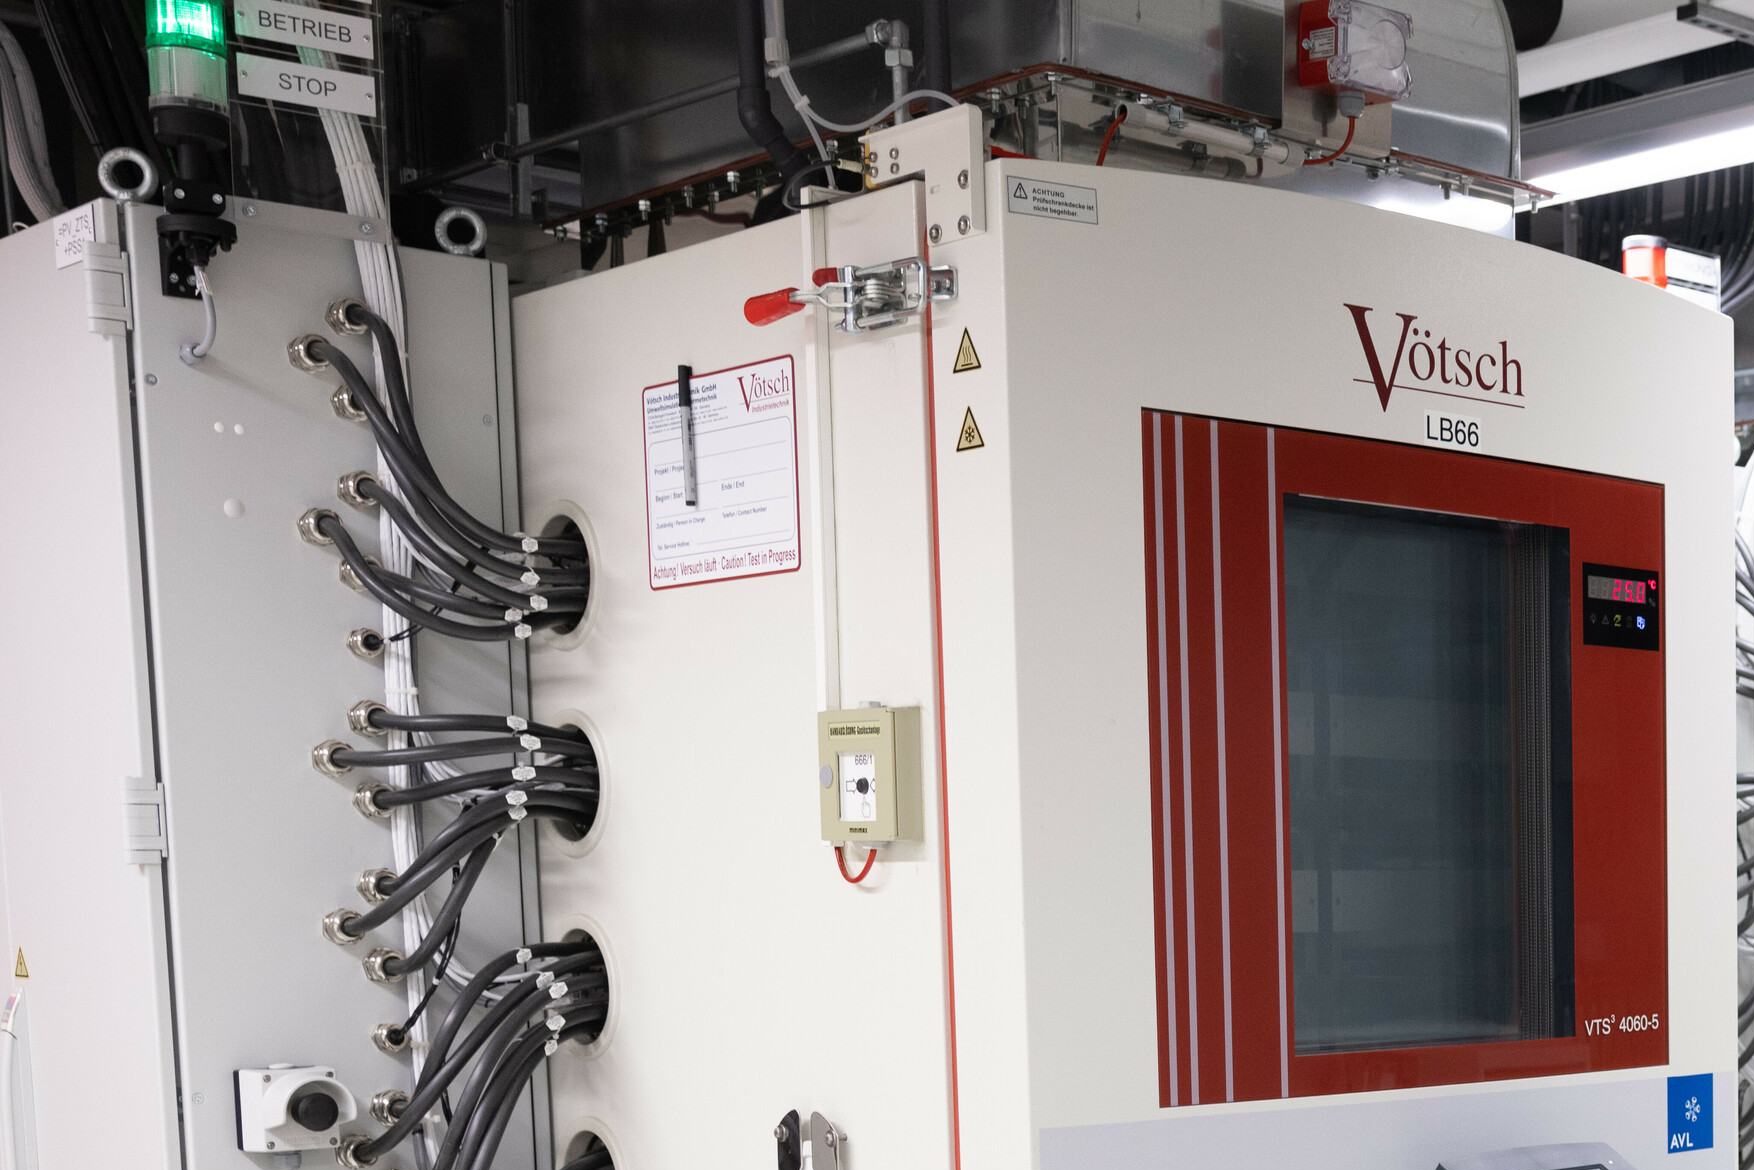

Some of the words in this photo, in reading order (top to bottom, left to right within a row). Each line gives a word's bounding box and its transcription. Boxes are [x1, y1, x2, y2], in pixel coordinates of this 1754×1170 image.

[258, 9, 352, 43] BETRIEB
[278, 72, 338, 97] STOP
[1032, 188, 1065, 198] ACHTUNG
[1032, 196, 1086, 210] Prüfschrankdecke
[1033, 205, 1048, 213] nicht
[1342, 302, 1526, 413] Vötsch
[647, 395, 662, 405] Vötsch
[701, 384, 717, 393] GmbH
[737, 369, 790, 413] Vötsch
[751, 399, 790, 414] Industrietechnik
[1426, 414, 1480, 448] LB66
[721, 482, 733, 491] Ende
[735, 480, 745, 488] End
[655, 494, 670, 503] Beginn
[673, 491, 683, 499] Start
[653, 562, 679, 580] Achtung!
[680, 560, 703, 576] Versuch
[721, 553, 747, 571] Caution!
[748, 551, 760, 567] Test
[761, 550, 767, 564] in
[768, 548, 796, 566] Progress
[1612, 579, 1646, 603] 25.0
[854, 754, 873, 766] 666/1
[1619, 1013, 1659, 1033] 4060-5
[1670, 1132, 1694, 1150] AVL
